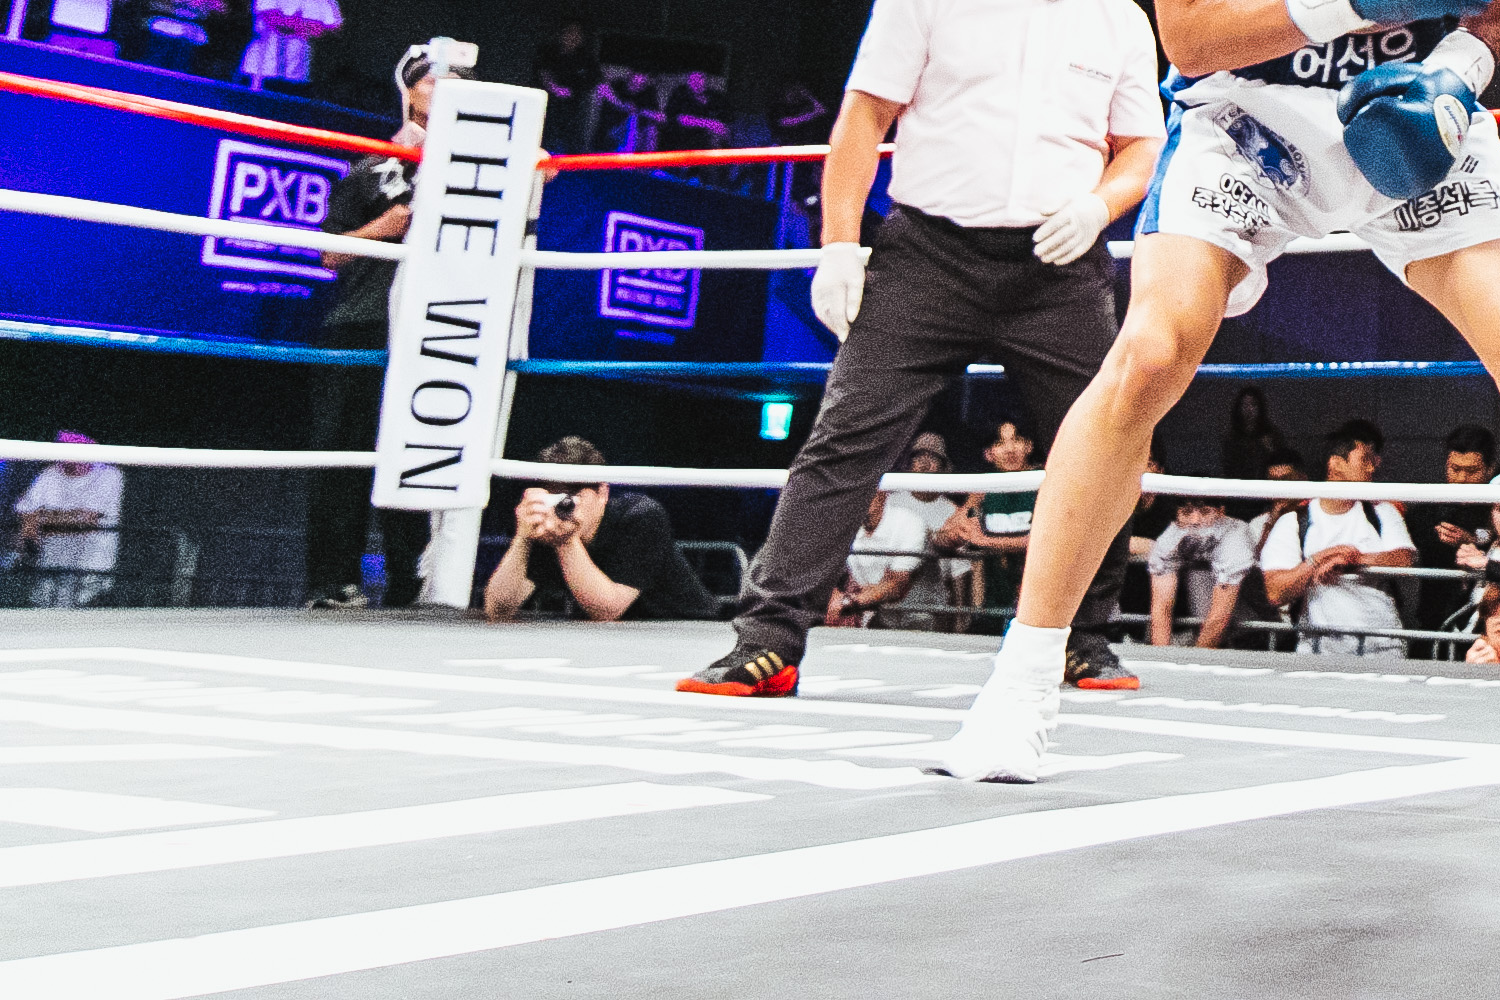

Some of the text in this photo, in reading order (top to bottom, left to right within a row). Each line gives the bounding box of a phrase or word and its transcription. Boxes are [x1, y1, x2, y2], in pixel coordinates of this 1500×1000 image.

[230, 161, 332, 225] PXB
[1219, 172, 1270, 219] OCEAN
[398, 101, 517, 492] THE WON
